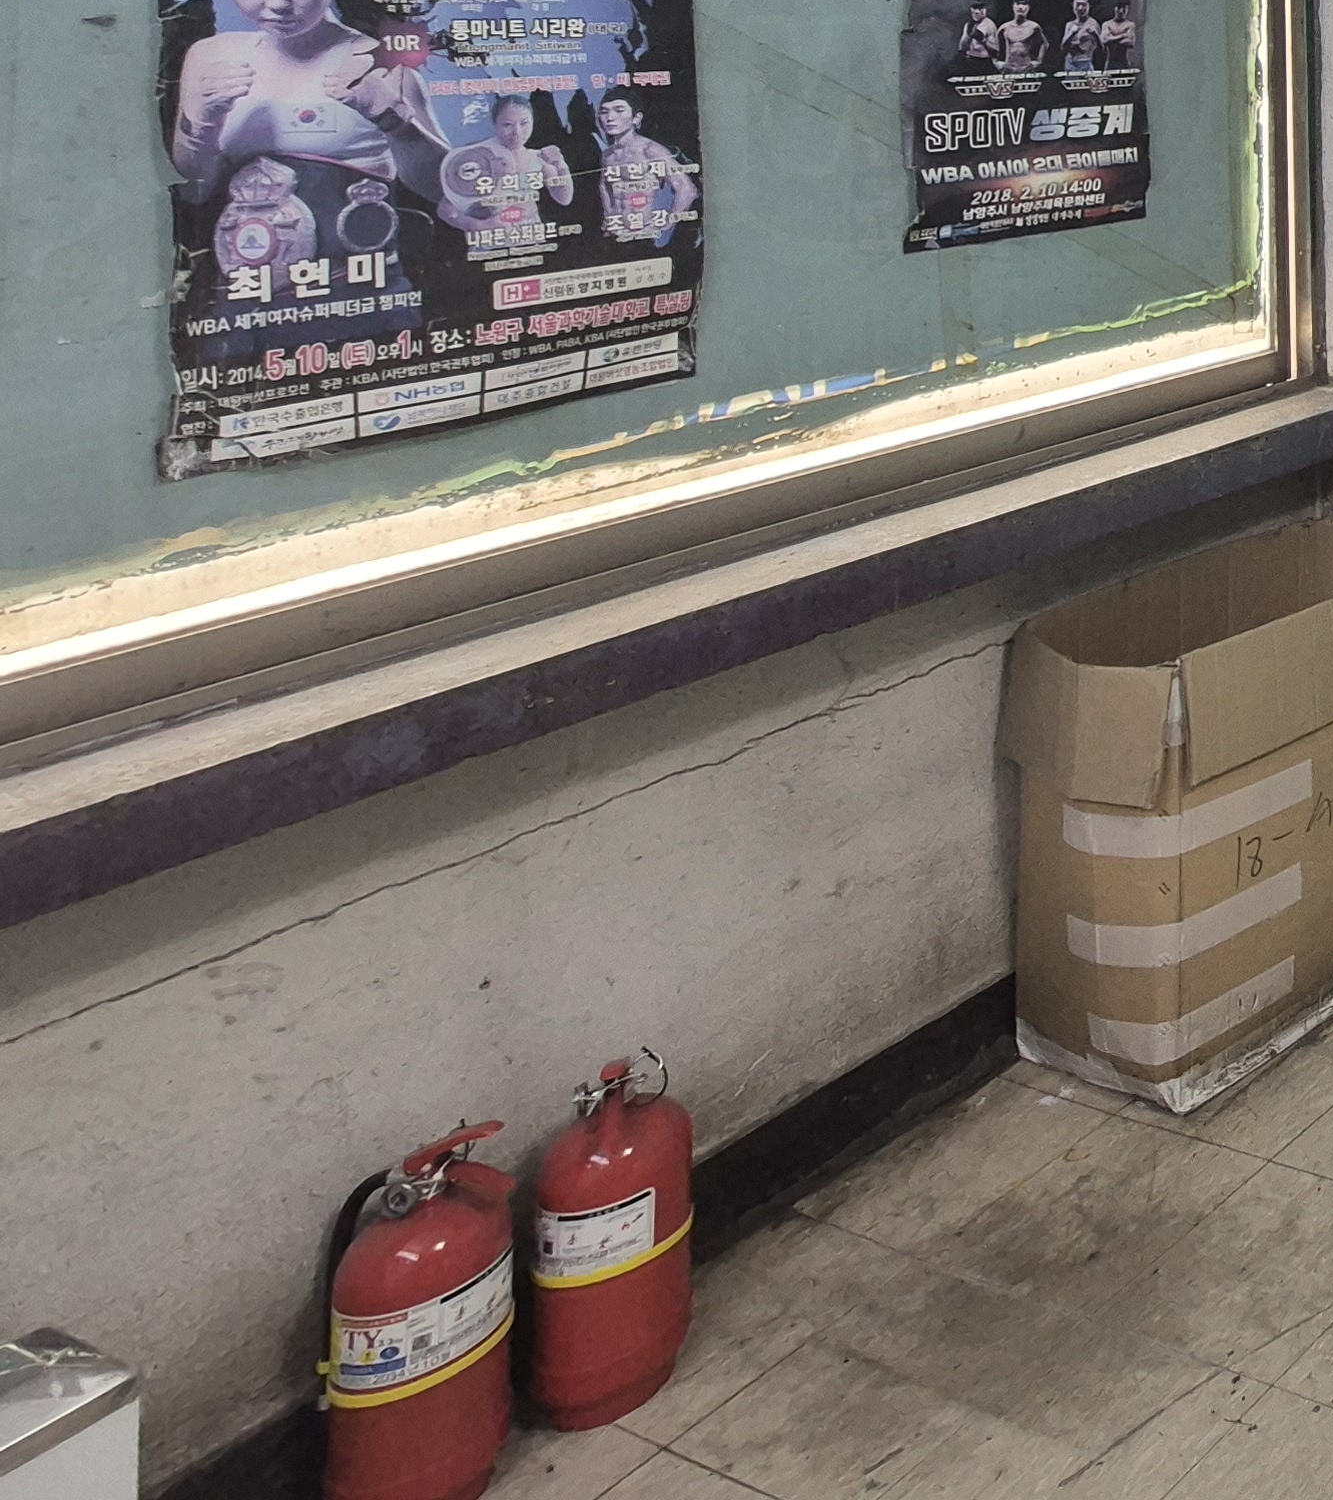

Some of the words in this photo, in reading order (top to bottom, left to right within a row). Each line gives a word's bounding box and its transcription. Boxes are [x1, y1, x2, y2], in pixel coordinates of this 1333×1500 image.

[530, 18, 586, 39] 시리완
[383, 35, 421, 53] 10R
[454, 55, 483, 68] WBA
[987, 81, 1014, 97] VS
[1087, 76, 1109, 90] VS
[924, 107, 1026, 153] SPOTV
[1029, 103, 1134, 142] 생중계
[921, 165, 975, 185] WBA
[977, 158, 1030, 181] 아시아
[1065, 146, 1139, 170] 타이틀매치
[475, 171, 545, 195] 유희정
[970, 188, 1016, 207] 2018.
[1039, 182, 1058, 198] 10
[1061, 177, 1103, 196] 14:00
[227, 251, 387, 303] 최현미
[186, 318, 232, 338] WBA
[234, 297, 376, 332] 세계여자슈퍼페더급
[379, 290, 423, 312] 챔피언
[181, 365, 224, 393] 일시:
[430, 328, 472, 355] 장소:
[474, 317, 524, 347] 노원구
[527, 296, 650, 337] 서울과학기술대학교
[653, 289, 693, 316] 특설링
[352, 372, 380, 386] KBA
[343, 1328, 383, 1352] TY
